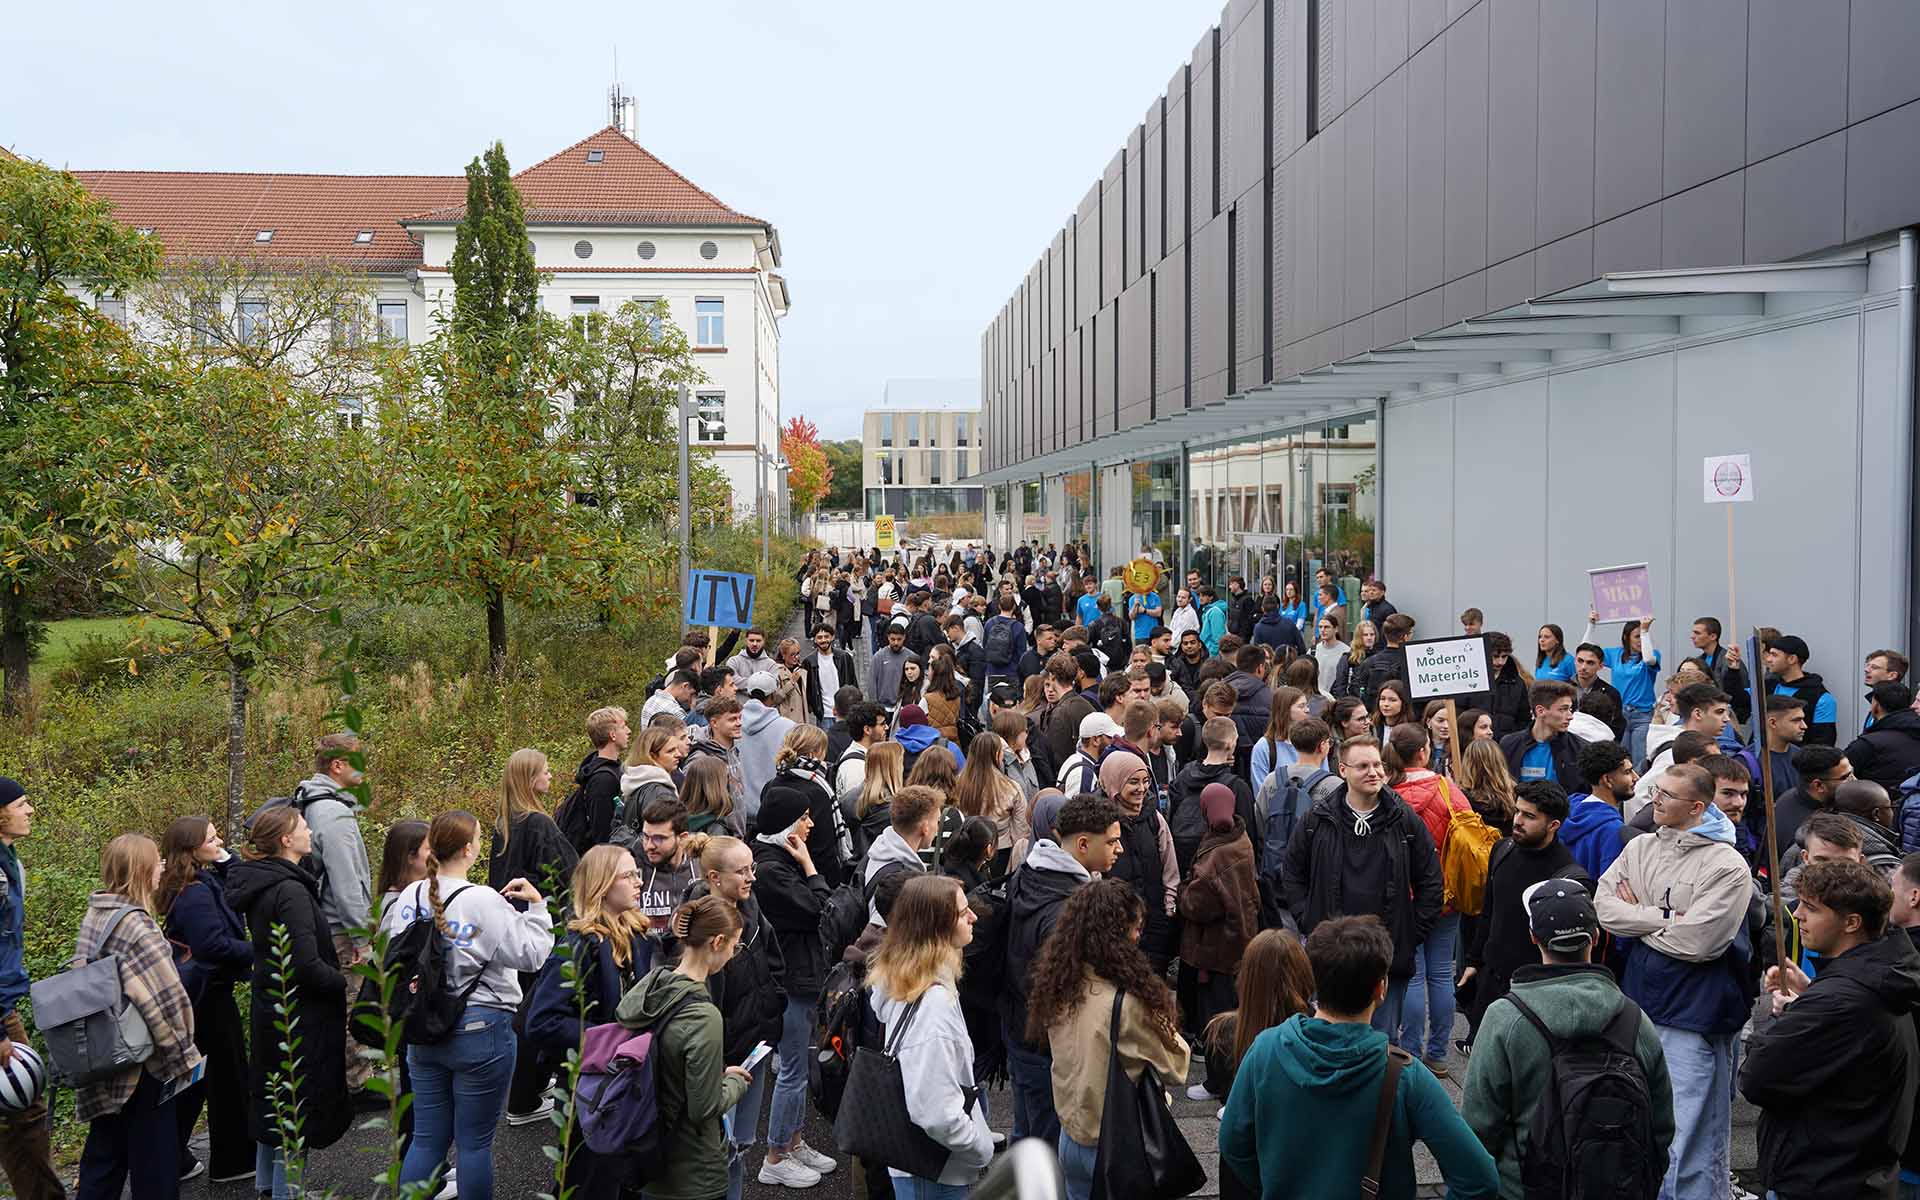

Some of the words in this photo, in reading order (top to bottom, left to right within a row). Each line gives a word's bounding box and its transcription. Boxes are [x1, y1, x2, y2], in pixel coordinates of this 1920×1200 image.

[1135, 571, 1149, 584] E3
[690, 574, 753, 624] ITV
[1416, 654, 1466, 667] Modern
[1418, 668, 1479, 683] Materials
